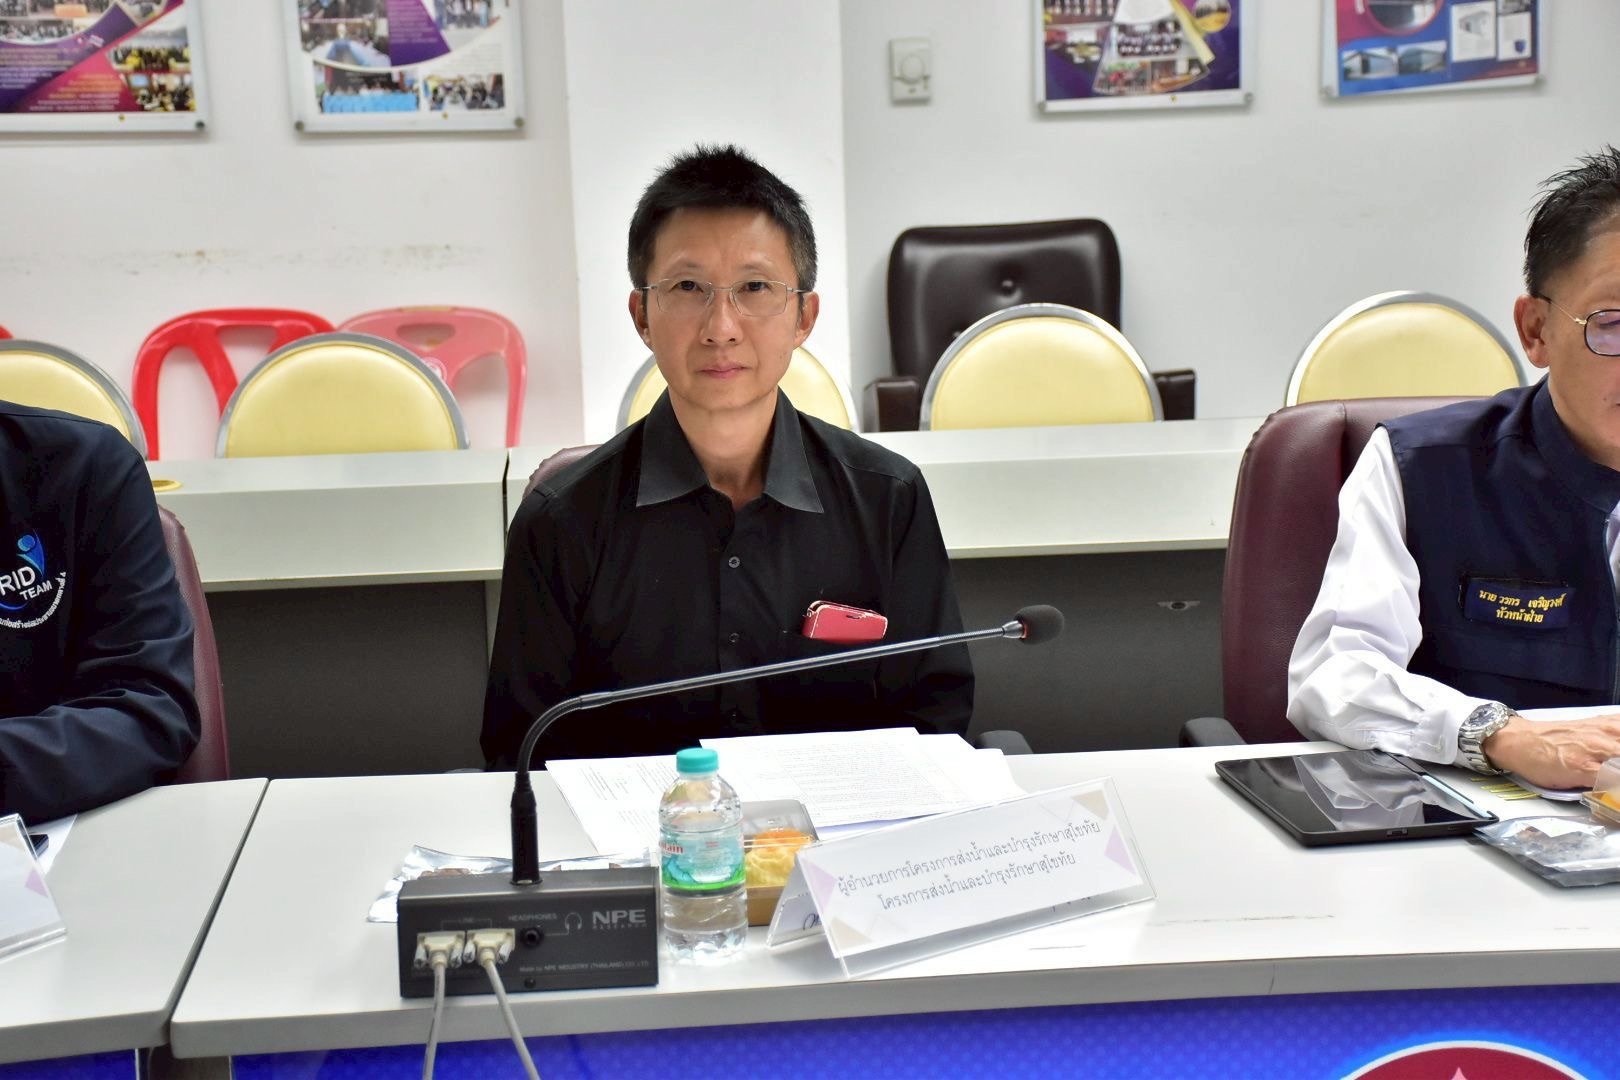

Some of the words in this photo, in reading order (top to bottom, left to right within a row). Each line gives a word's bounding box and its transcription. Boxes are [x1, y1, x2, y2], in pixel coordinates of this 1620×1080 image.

[19, 580, 53, 600] TEAM
[1479, 589, 1498, 602] นาย
[1499, 595, 1520, 606] วรกร
[1528, 593, 1567, 611] เจริญวงศ์
[1496, 606, 1544, 622] หัวหน้าฝ่าย
[837, 819, 1101, 897] ผู้อำนวยการโครงการส่งน้ำและบำรุงรักษาสุโขทัย
[877, 850, 1076, 910] โครงการส่งน้ำและบำรุงรักษาสุโขทัย
[508, 912, 558, 922] HEADPHONES
[592, 909, 646, 924] NPE
